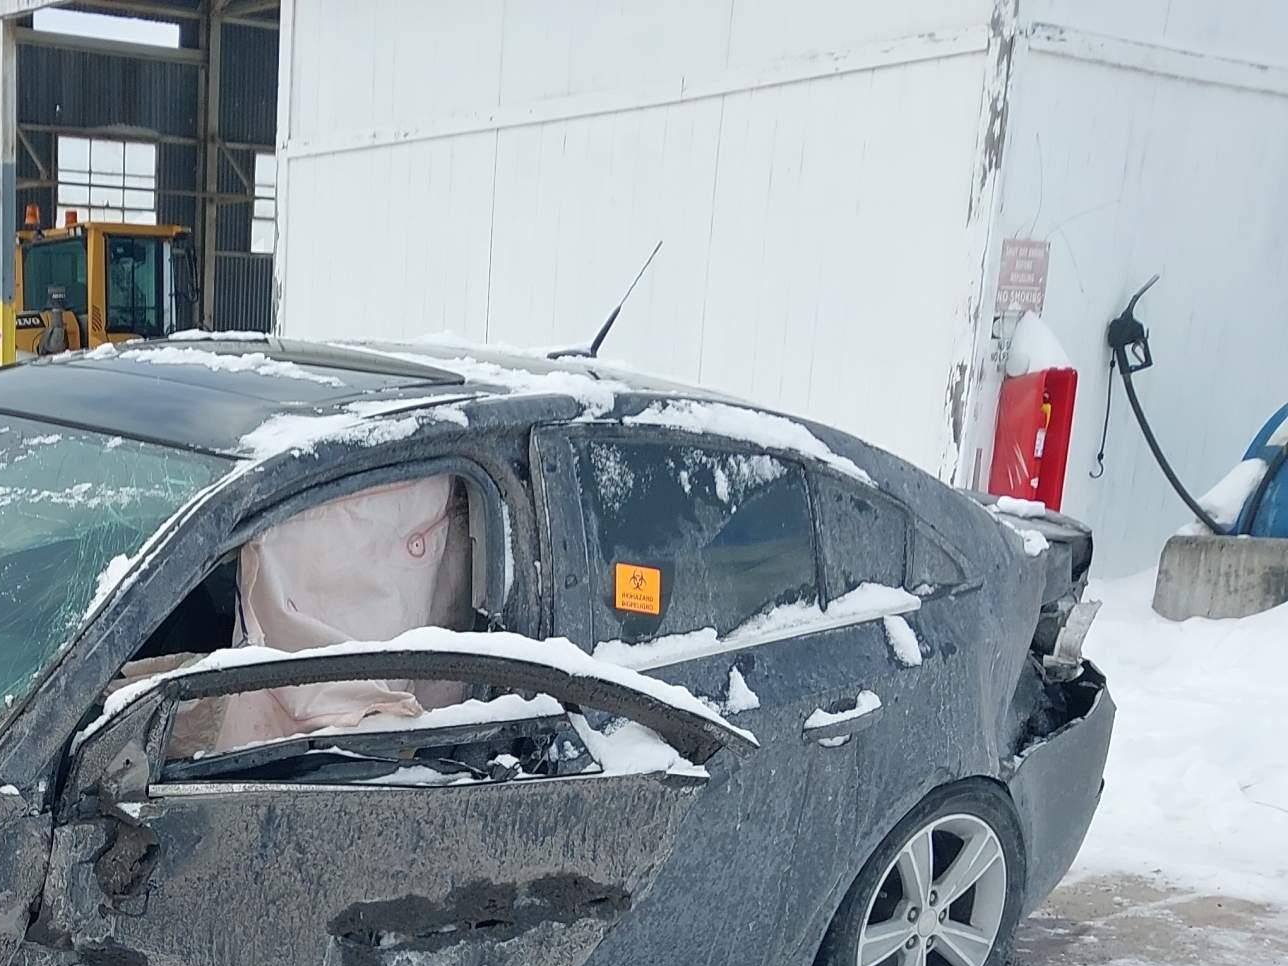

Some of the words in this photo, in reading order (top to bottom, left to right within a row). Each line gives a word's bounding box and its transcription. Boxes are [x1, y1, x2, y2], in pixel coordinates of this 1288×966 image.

[997, 289, 1009, 302] NO
[1010, 289, 1042, 303] SMOKING
[16, 317, 40, 326] LVO
